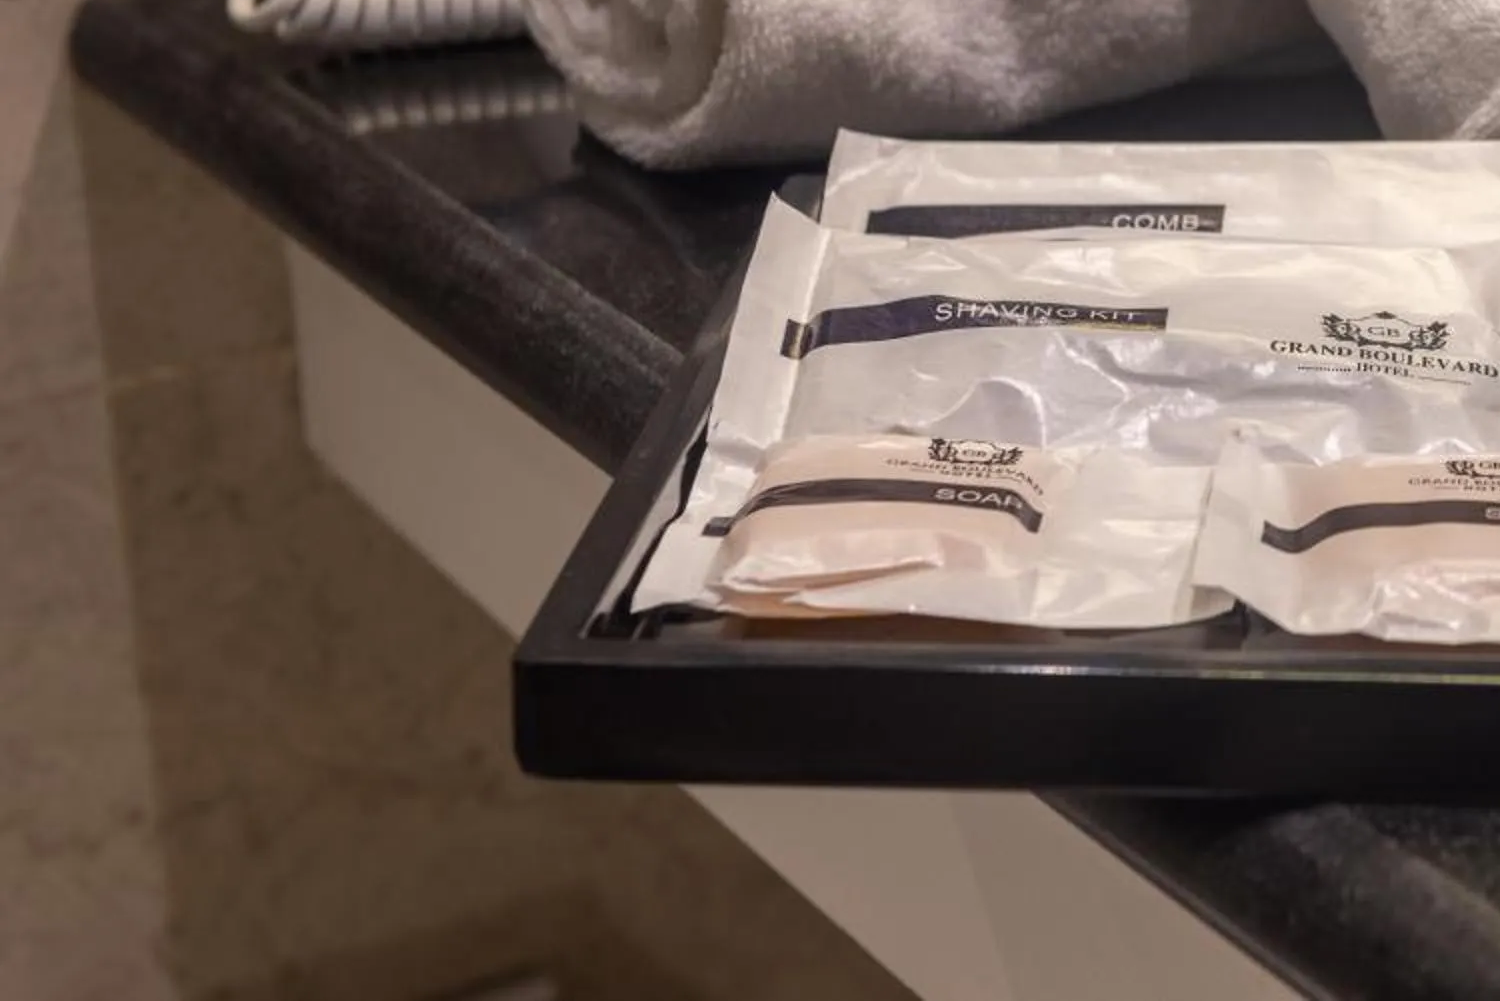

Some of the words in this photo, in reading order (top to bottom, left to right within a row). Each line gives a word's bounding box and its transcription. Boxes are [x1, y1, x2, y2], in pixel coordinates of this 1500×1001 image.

[1111, 213, 1200, 232] COMB
[934, 301, 1078, 322] SHAVING
[1089, 309, 1142, 322] KIT
[1367, 325, 1401, 338] GB
[1269, 339, 1353, 358] GRAND
[1358, 348, 1500, 379] BOULEVARD
[1356, 362, 1416, 379] HOTEL
[934, 487, 1023, 510] SOAP
